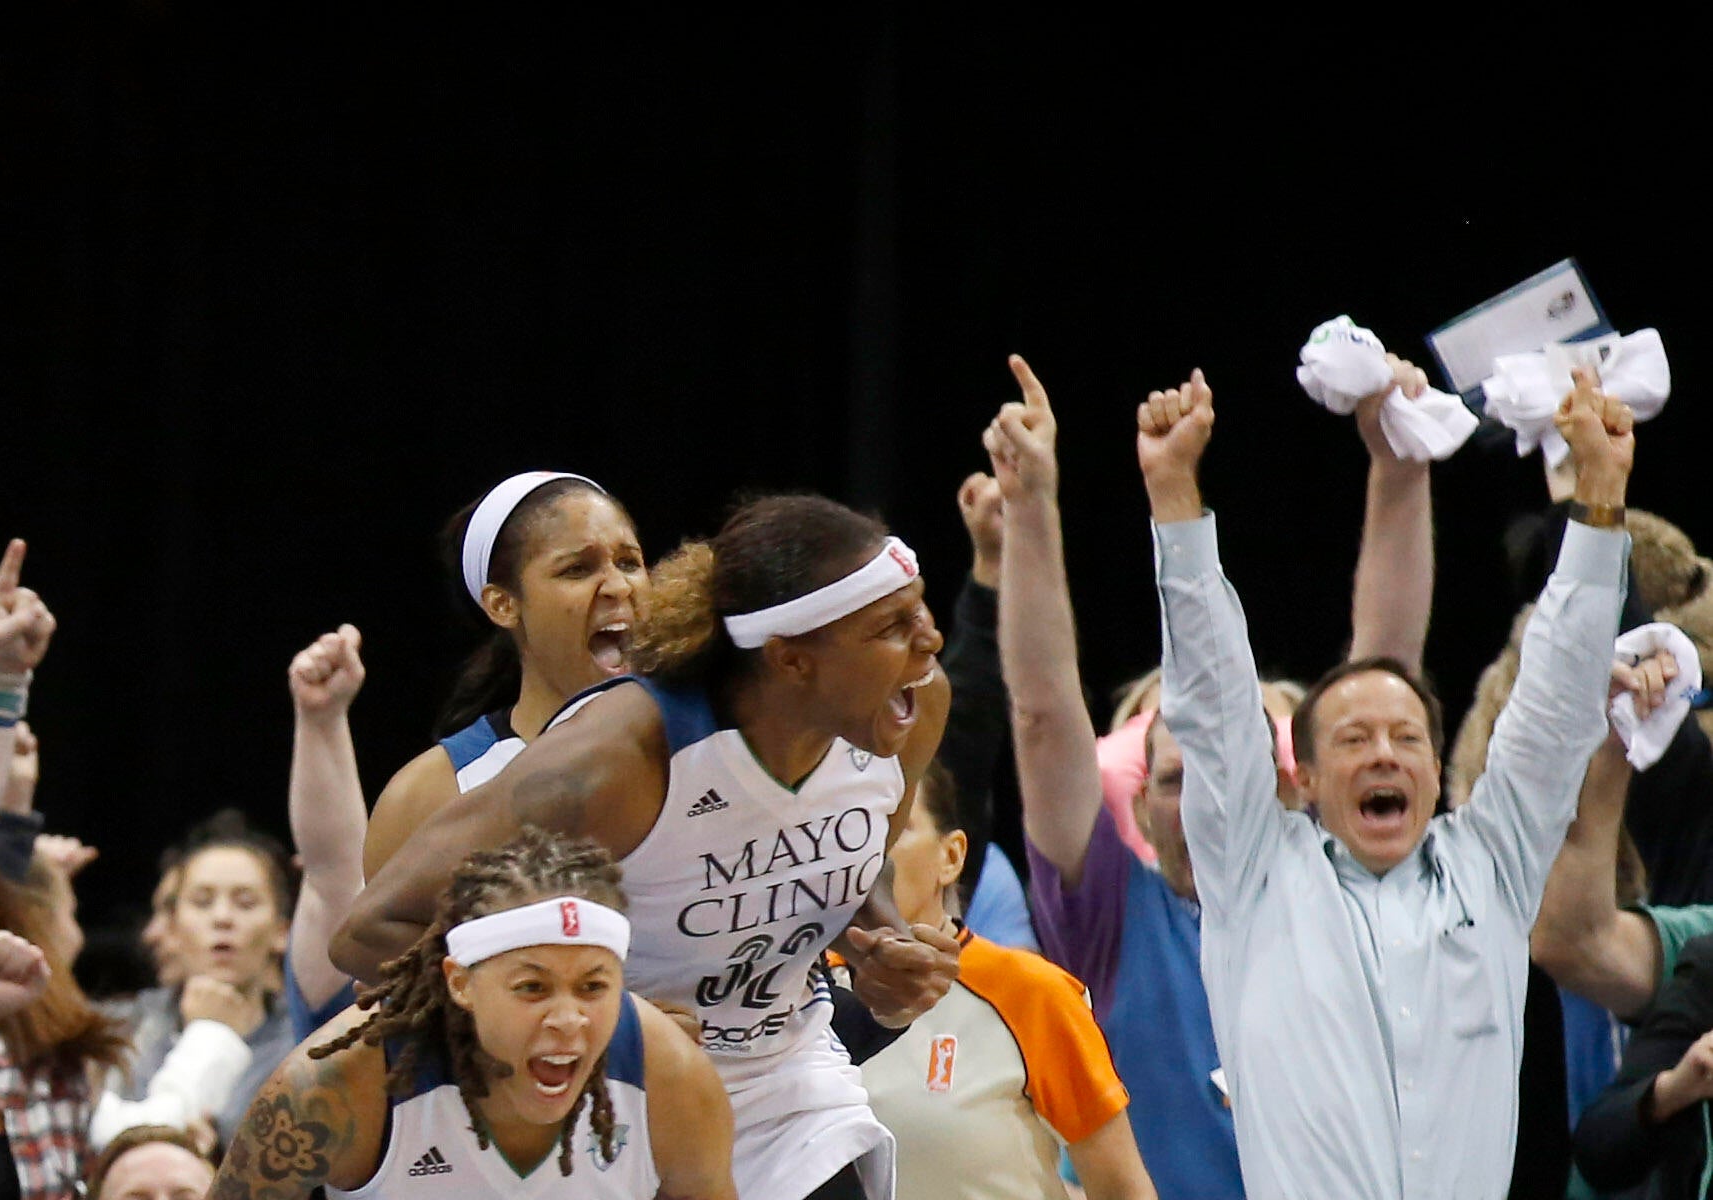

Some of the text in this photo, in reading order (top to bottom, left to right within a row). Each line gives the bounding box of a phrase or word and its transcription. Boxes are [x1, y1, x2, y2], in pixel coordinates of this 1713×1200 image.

[698, 806, 872, 892] MAYO
[676, 851, 882, 938] CLINIC
[408, 1163, 453, 1177] adidas
